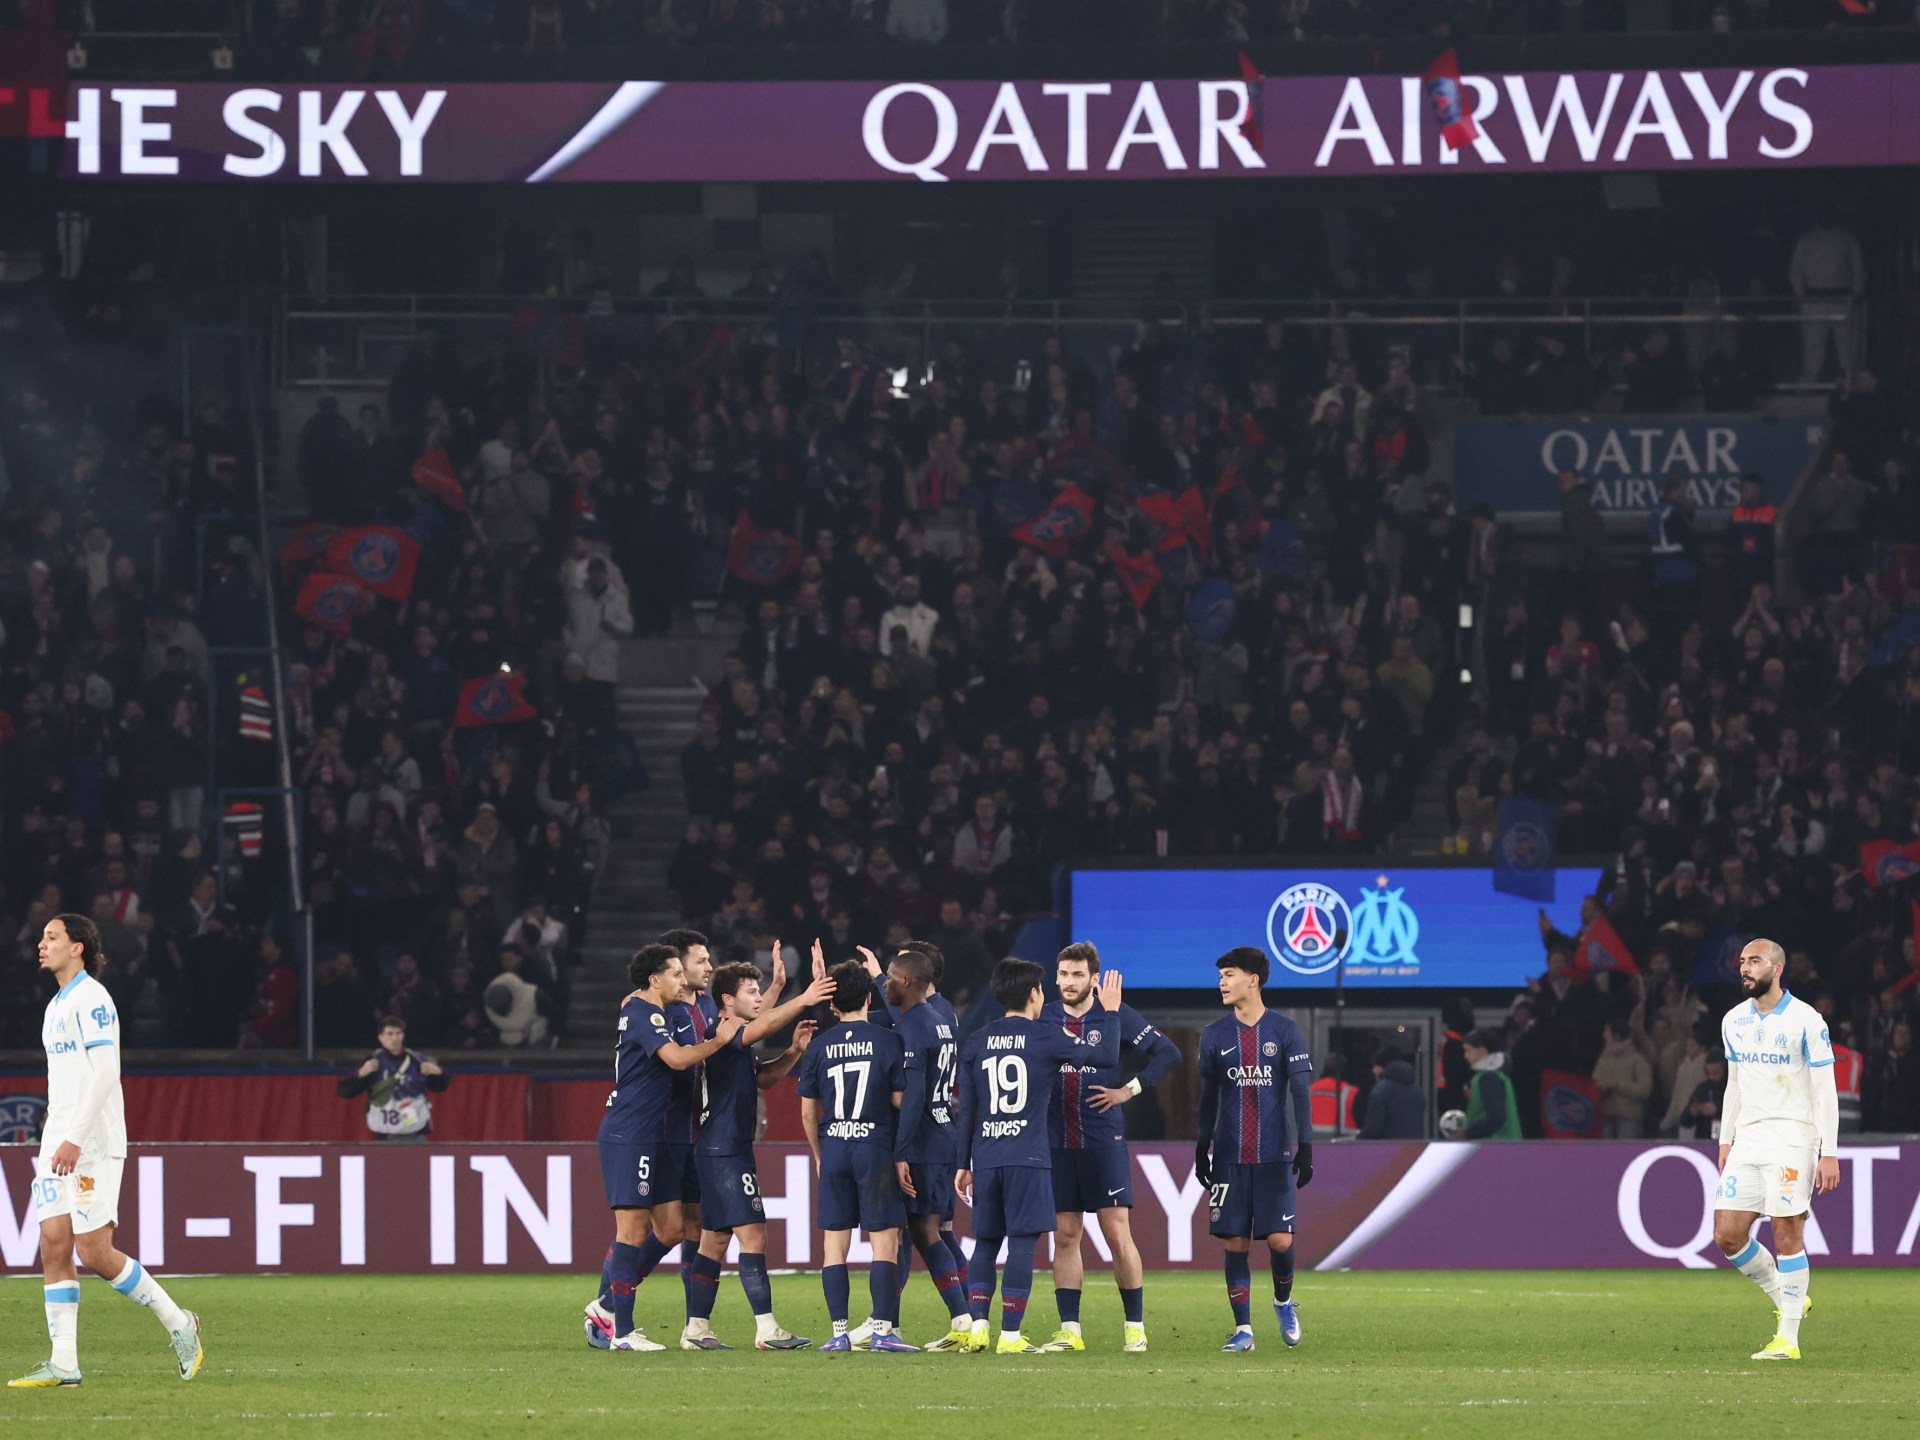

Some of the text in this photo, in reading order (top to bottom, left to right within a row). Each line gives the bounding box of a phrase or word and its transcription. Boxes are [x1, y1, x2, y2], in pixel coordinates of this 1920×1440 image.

[0, 87, 447, 177] HE SKY
[861, 68, 1814, 182] QATAR AIRWAYS
[1541, 427, 1740, 475] QATAR
[1281, 887, 1338, 911] PARIS
[826, 1041, 873, 1059] VITINHA
[987, 1035, 1026, 1049] KANG IN
[1761, 1053, 1790, 1064] CGM
[1227, 1065, 1272, 1080] QATAR
[1237, 1078, 1272, 1086] AIRWAYS
[827, 1060, 872, 1119] 17
[982, 1055, 1028, 1115] 19
[827, 1121, 869, 1140] snipes
[638, 1156, 650, 1179] 5
[33, 1179, 57, 1208] 26
[1209, 1183, 1229, 1207] 27
[430, 1156, 572, 1265] IN
